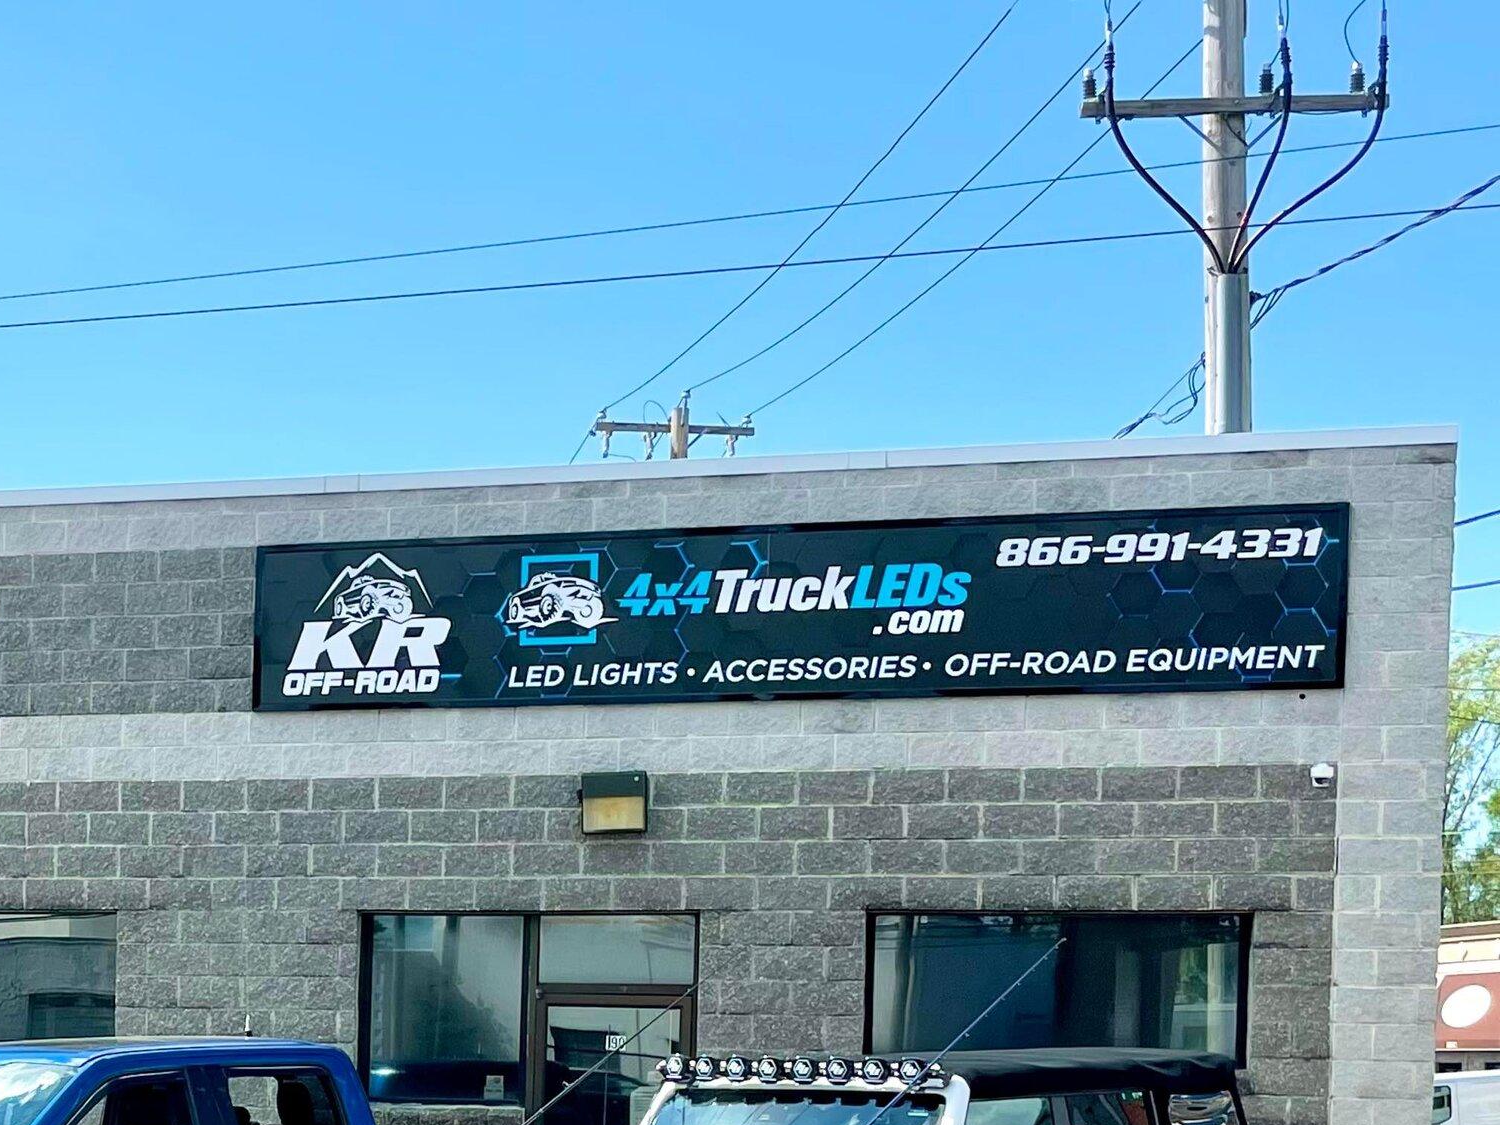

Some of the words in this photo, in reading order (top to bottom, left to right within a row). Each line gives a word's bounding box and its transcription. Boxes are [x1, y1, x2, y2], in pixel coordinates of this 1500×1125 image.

[996, 527, 1323, 566] 866-991-4331
[616, 562, 972, 616] 4x4TruckLEDs
[872, 608, 964, 635] .com
[287, 617, 452, 671] KR
[282, 669, 440, 697] OFF-ROAD
[508, 664, 565, 688] LED
[573, 662, 678, 687] LIGHTS
[702, 655, 918, 683] ACCESSORIES
[945, 649, 1117, 678] OFF-ROAD
[1126, 643, 1325, 674] EQUIPMENT
